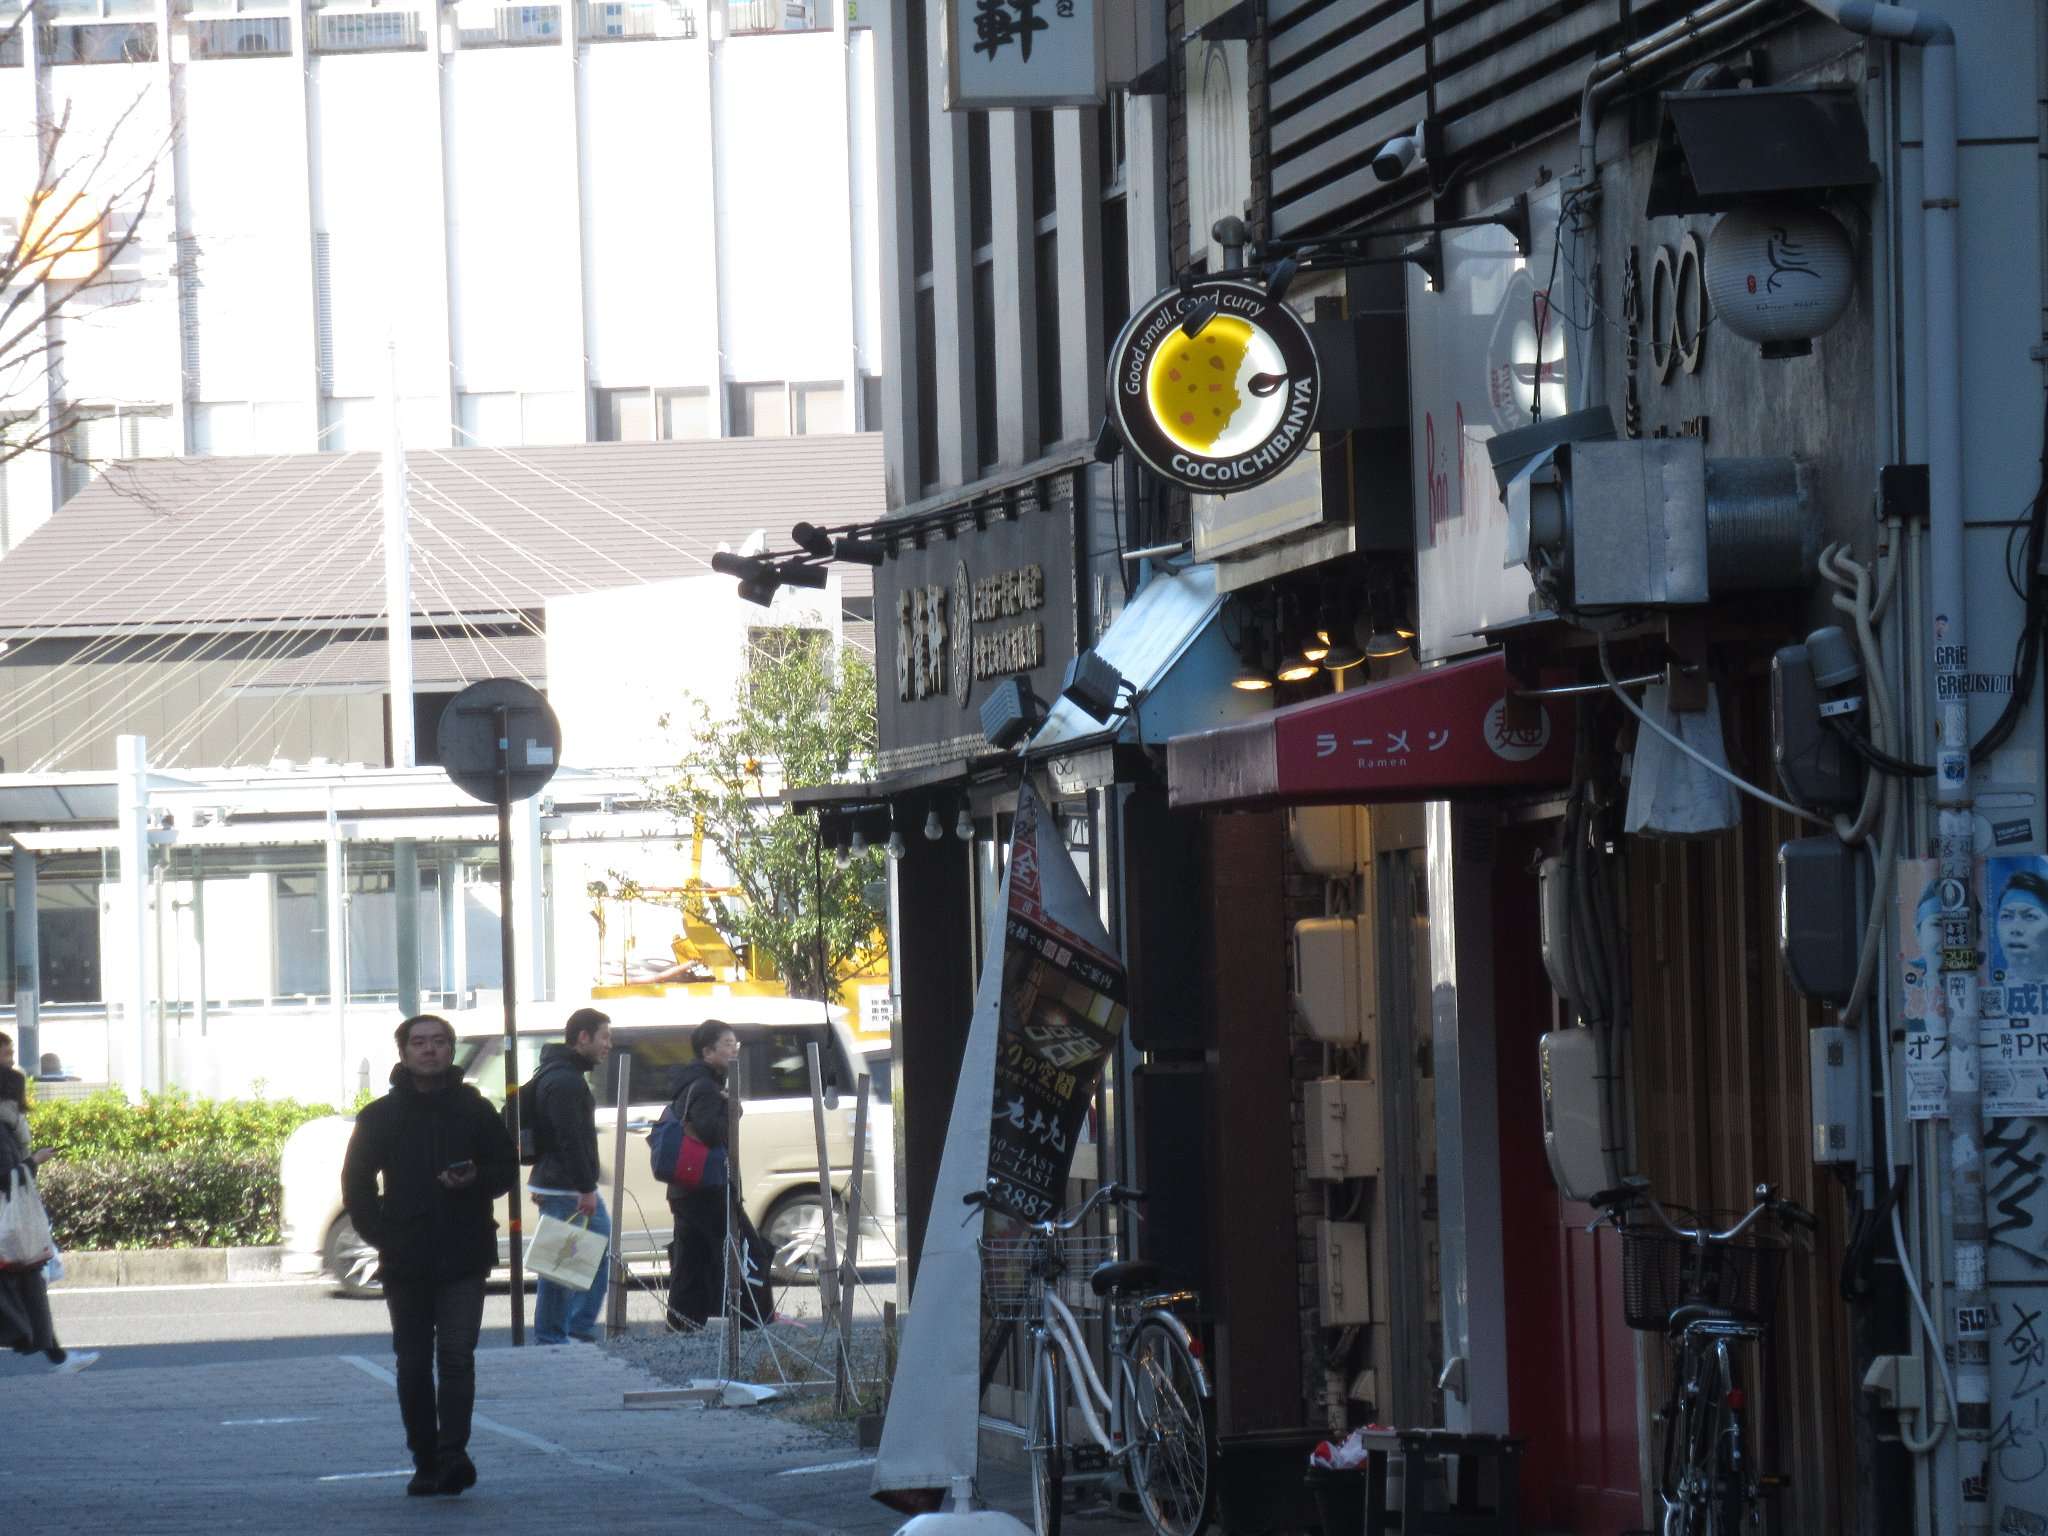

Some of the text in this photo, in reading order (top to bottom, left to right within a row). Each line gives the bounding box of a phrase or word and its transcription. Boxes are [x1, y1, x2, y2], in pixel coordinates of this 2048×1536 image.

[1126, 346, 1146, 395] Good
[1223, 294, 1267, 317] curry
[1171, 376, 1313, 481] CoCoICHIBANYA
[1316, 730, 1449, 758] ラーメン
[1358, 758, 1408, 770] Ramen
[1907, 1035, 1998, 1061] ポスー
